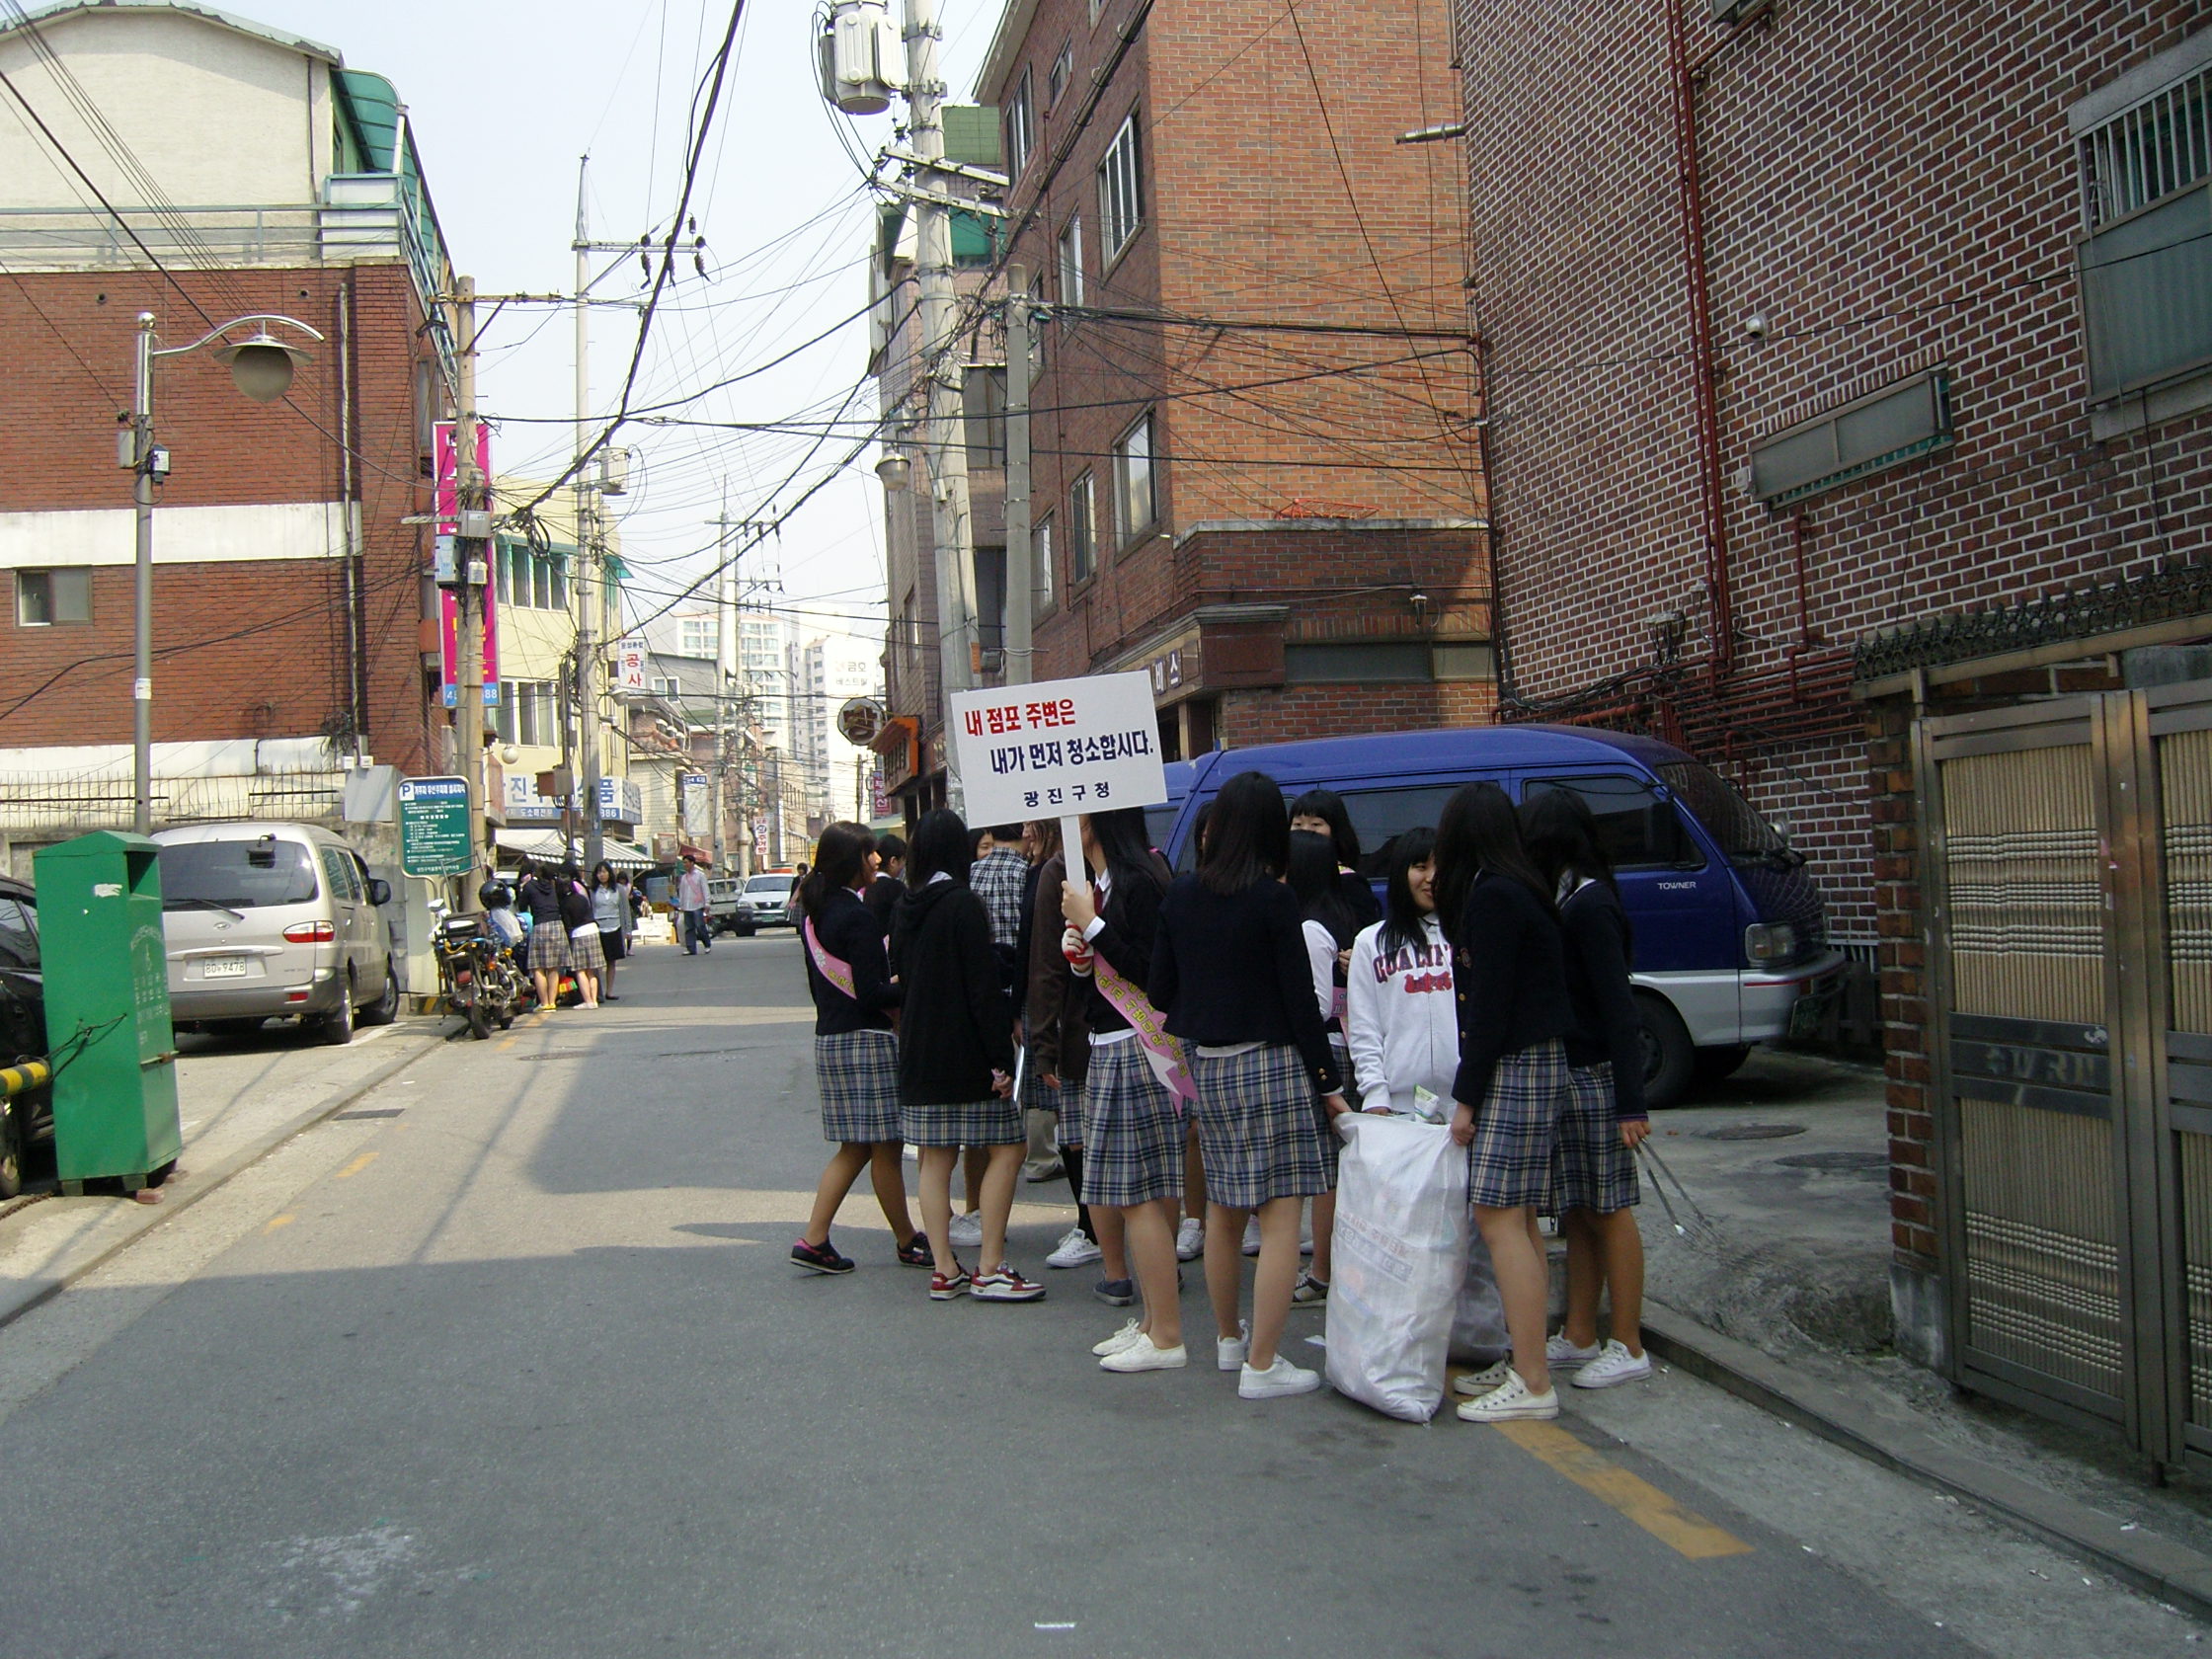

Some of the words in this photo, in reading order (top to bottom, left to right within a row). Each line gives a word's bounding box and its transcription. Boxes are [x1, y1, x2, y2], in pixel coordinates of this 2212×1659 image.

[625, 653, 642, 687] 공사
[964, 710, 984, 737] 내
[986, 705, 1022, 735] 점포
[1025, 698, 1076, 730] 주변은
[990, 746, 1025, 775] 내가
[1029, 741, 1064, 770] 먼저
[1066, 730, 1154, 766] 청소합시다.
[1023, 781, 1111, 808] 광진구청
[1657, 881, 1697, 890] TOWNER
